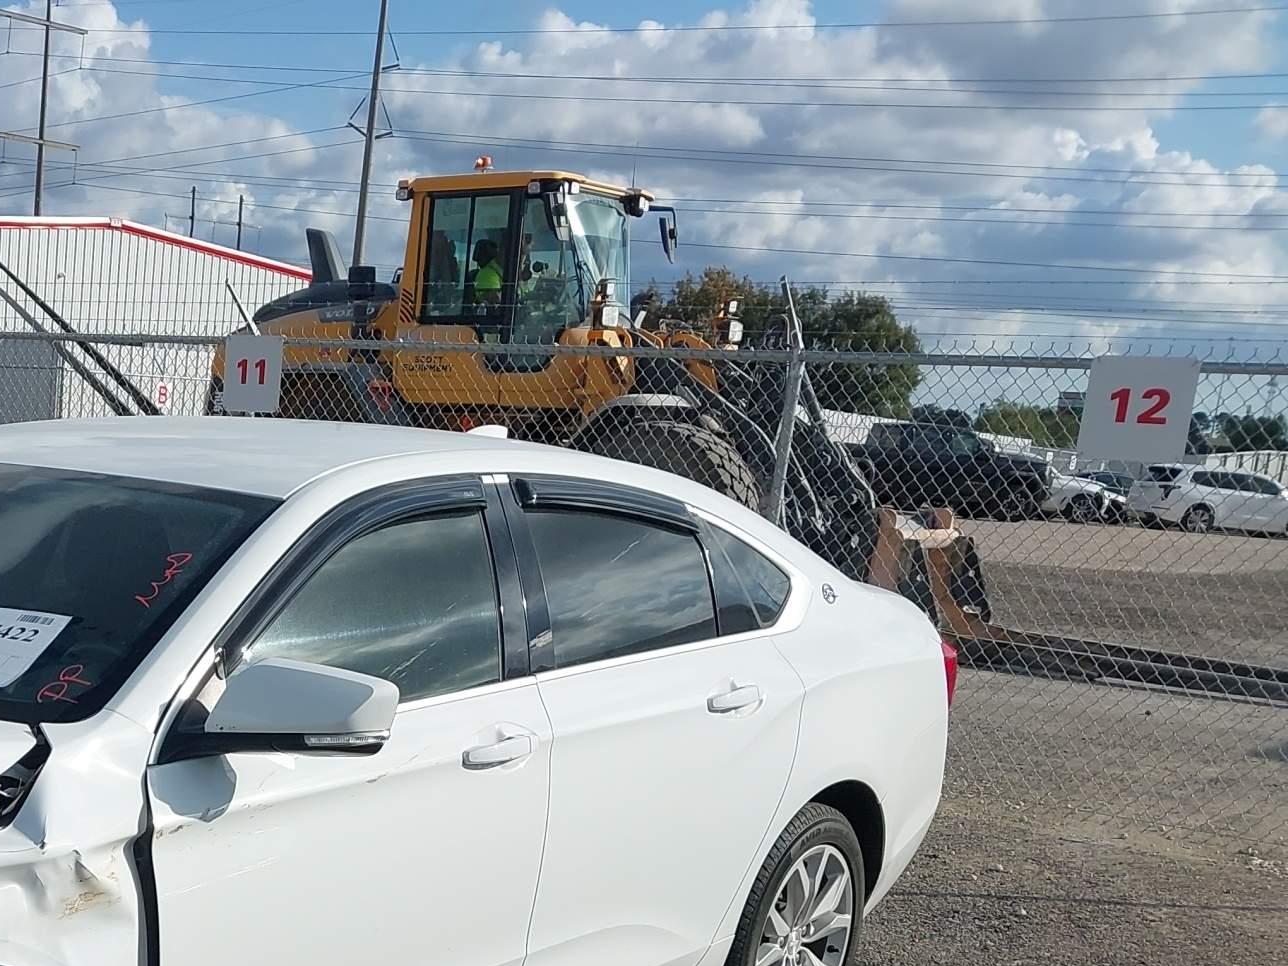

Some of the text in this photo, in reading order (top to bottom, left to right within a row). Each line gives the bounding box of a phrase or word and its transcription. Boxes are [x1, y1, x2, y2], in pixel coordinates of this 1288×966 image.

[403, 363, 453, 372] EQUIPMENT
[415, 355, 443, 363] SCOTT
[237, 358, 266, 385] 11
[158, 385, 168, 404] B
[1110, 387, 1171, 425] 12
